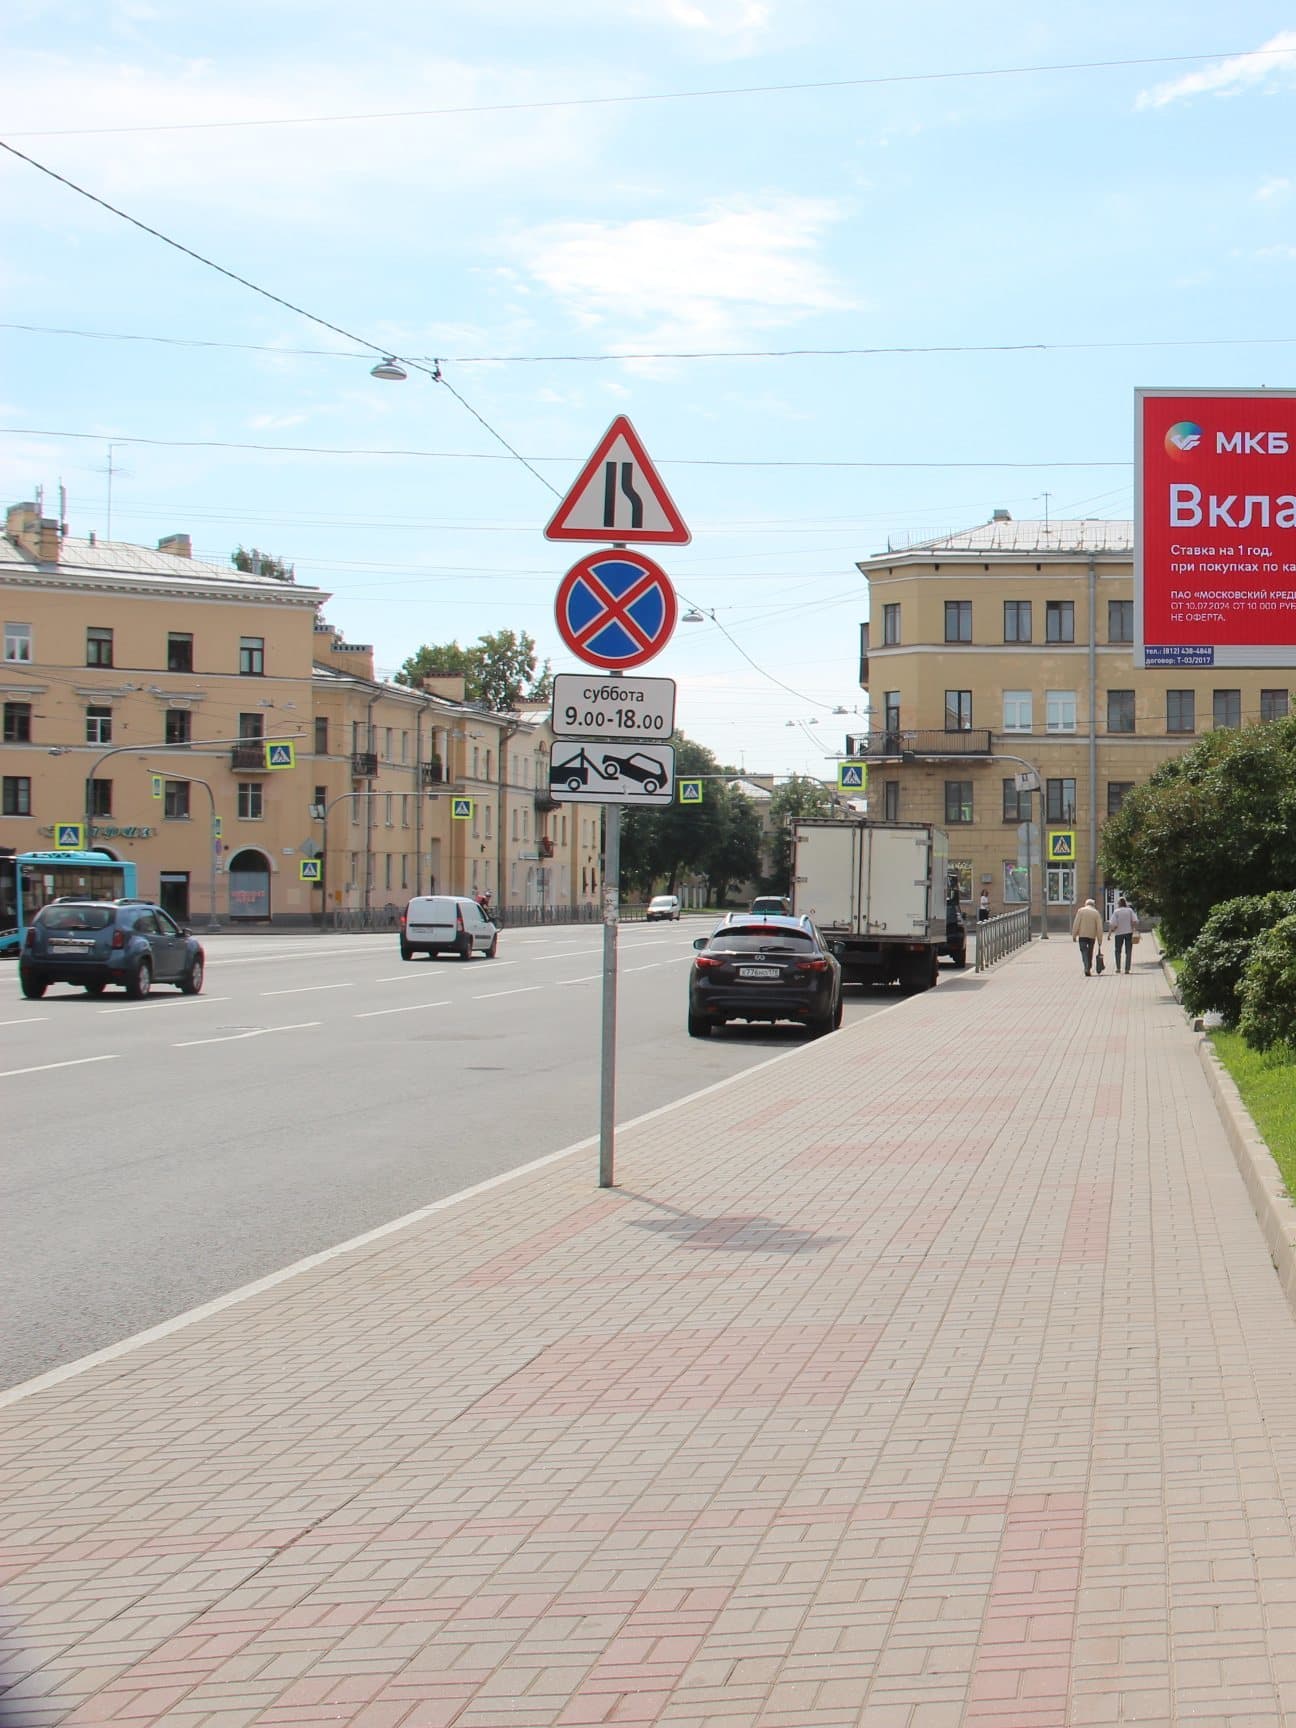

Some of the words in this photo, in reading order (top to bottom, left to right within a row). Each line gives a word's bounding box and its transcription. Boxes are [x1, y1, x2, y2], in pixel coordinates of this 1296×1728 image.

[1216, 431, 1289, 454] МКБ
[1170, 544, 1216, 555] Ставка
[1219, 547, 1234, 555] на
[1238, 544, 1243, 555] 1
[1247, 546, 1273, 557] год,
[1170, 562, 1195, 574] при
[1199, 562, 1259, 574] покупках
[1263, 562, 1278, 572] по
[1170, 590, 1192, 599] ПАО
[1194, 589, 1268, 600] «МОСКОВСКИЙ
[1170, 602, 1184, 610] ОТ
[1232, 602, 1245, 610] ОТ
[1247, 602, 1257, 610] 10
[1170, 613, 1184, 621] НЕ
[1185, 613, 1226, 622] ОФЕРТА.
[583, 686, 645, 703] суббота
[565, 706, 664, 730] 9.00-18.00
